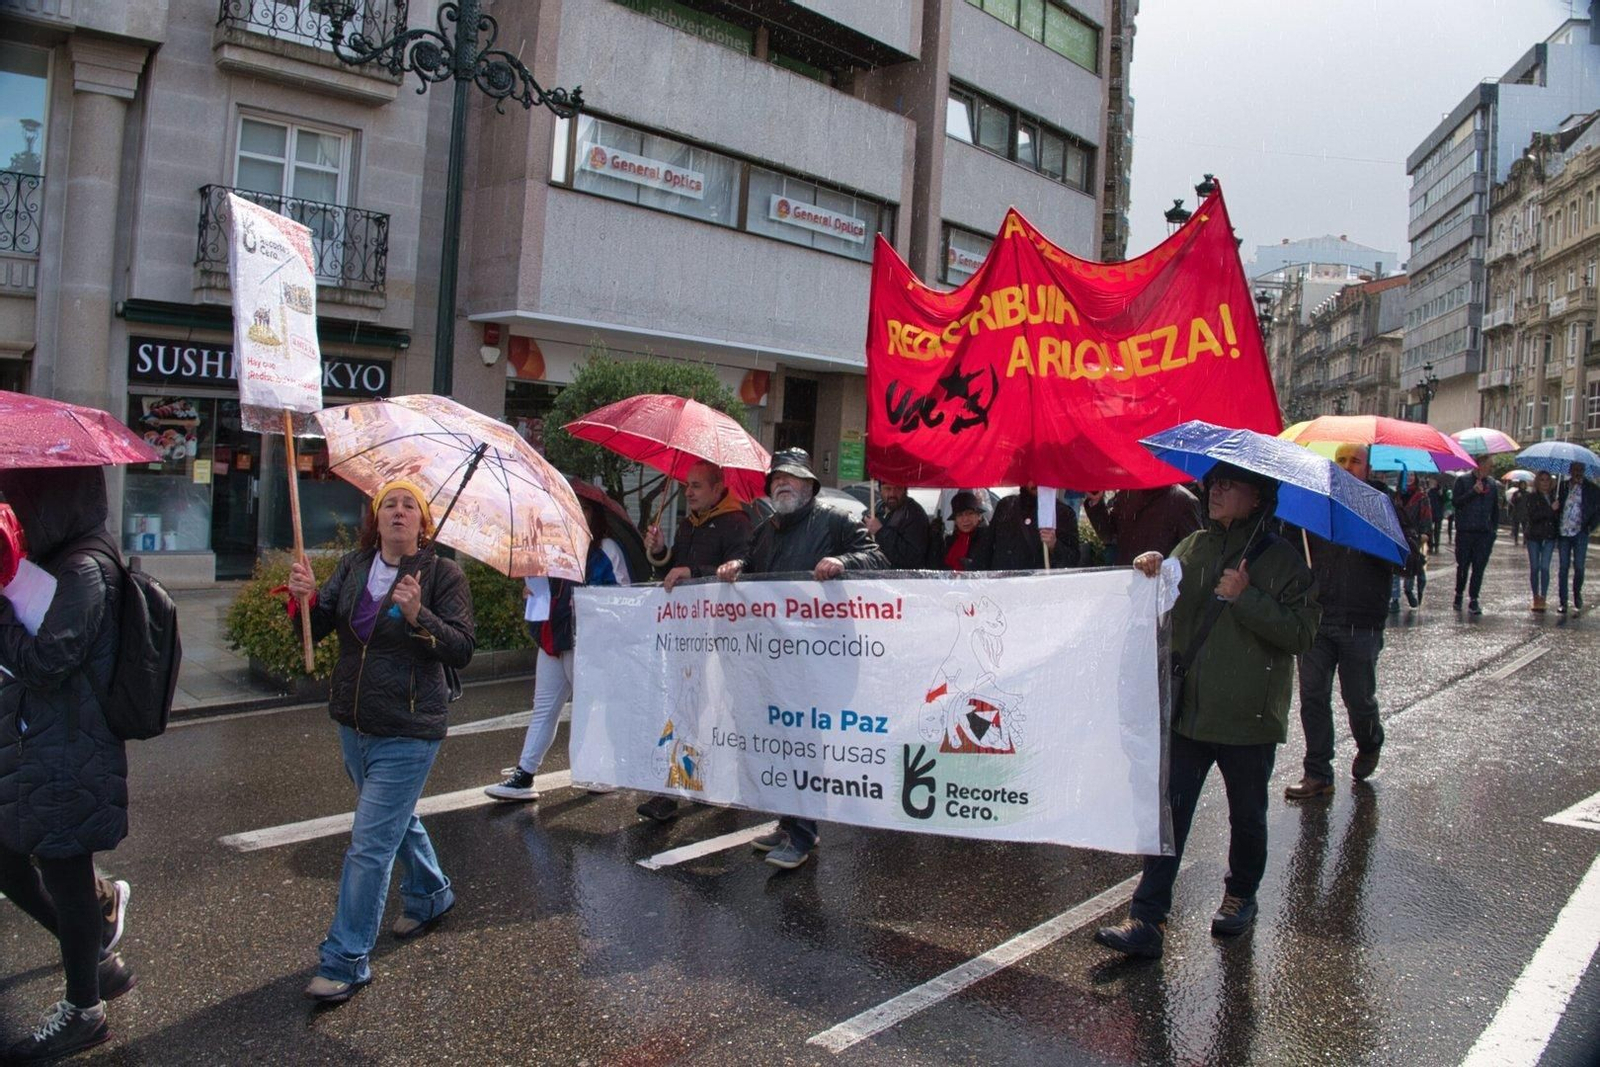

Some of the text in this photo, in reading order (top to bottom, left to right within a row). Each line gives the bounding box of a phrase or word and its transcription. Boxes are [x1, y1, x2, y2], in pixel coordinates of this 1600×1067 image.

[651, 6, 750, 52] subvenciones
[611, 154, 702, 192] General Optica
[793, 205, 864, 237] General Optica
[959, 253, 983, 269] Gener
[136, 343, 238, 380] SUSHI
[322, 363, 386, 392] KYO
[657, 596, 902, 622] ¡Alto al Fuego en Palestina!
[656, 633, 885, 659] Ni terrorismo, Ni genocidio
[768, 705, 888, 734] Por la Paz
[752, 733, 816, 761] tropas
[822, 743, 887, 765] rusas
[761, 765, 883, 800] de Ucrania
[945, 782, 1029, 805] Recortes
[945, 801, 999, 821] Cero.
